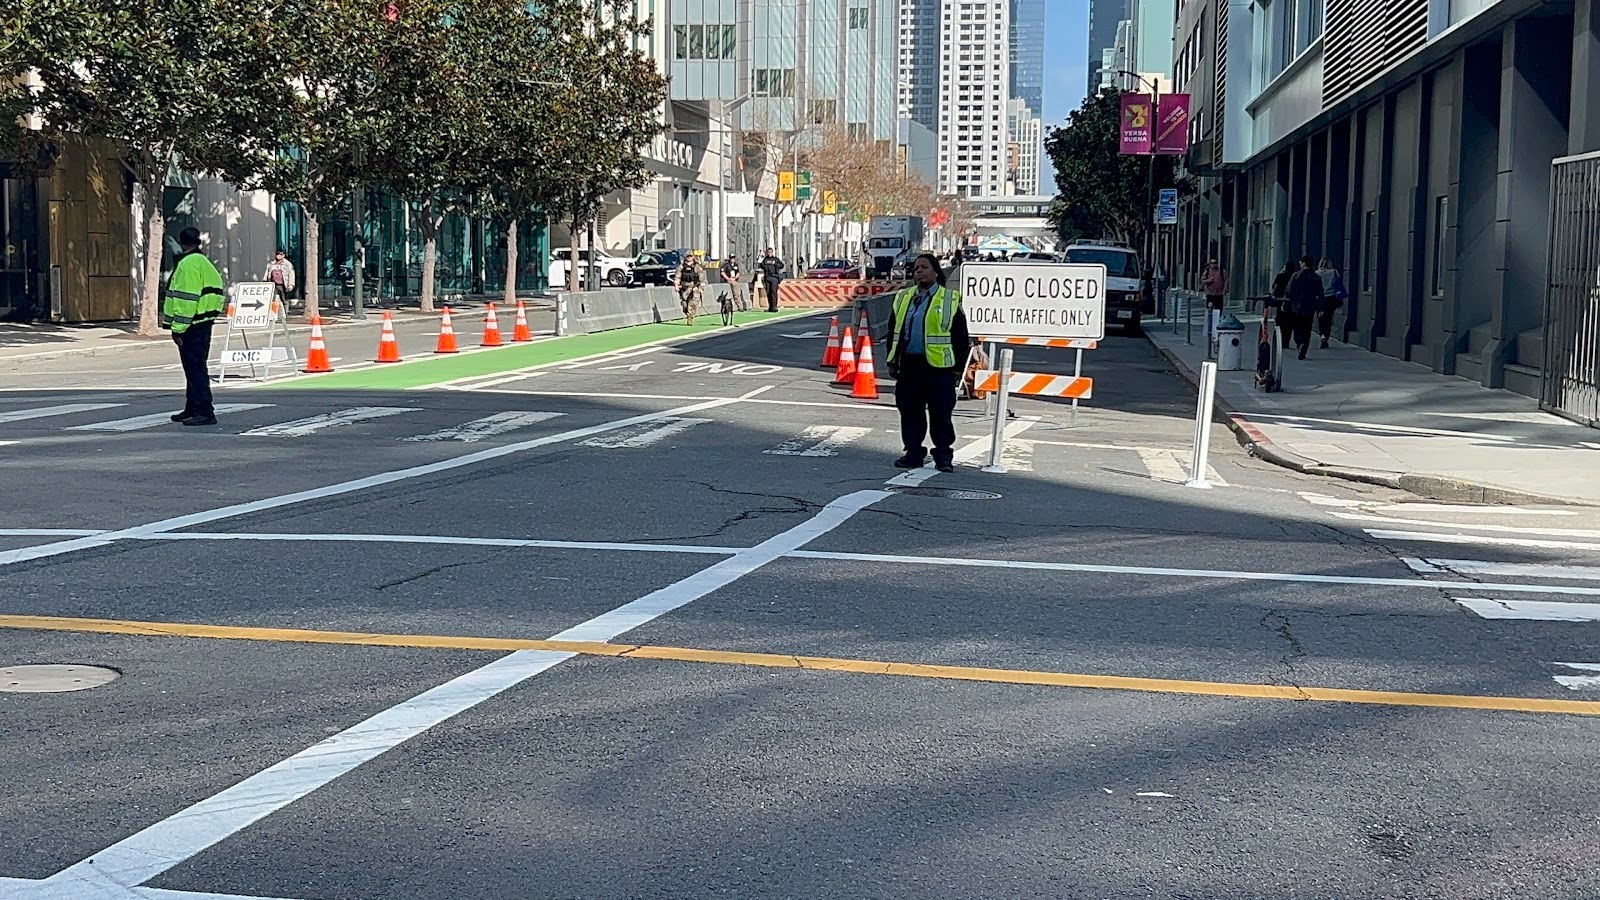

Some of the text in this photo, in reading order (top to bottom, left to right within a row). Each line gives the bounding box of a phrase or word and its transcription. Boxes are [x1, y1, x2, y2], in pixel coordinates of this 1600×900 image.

[242, 286, 270, 296] KEEP
[824, 285, 885, 296] STOP
[966, 276, 1098, 299] ROAD CLOSED
[235, 315, 267, 325] RIGHT
[969, 307, 1093, 326] LOCAL TRAFFIC ONLY
[231, 351, 260, 362] CMC
[598, 360, 784, 376] ONLY
